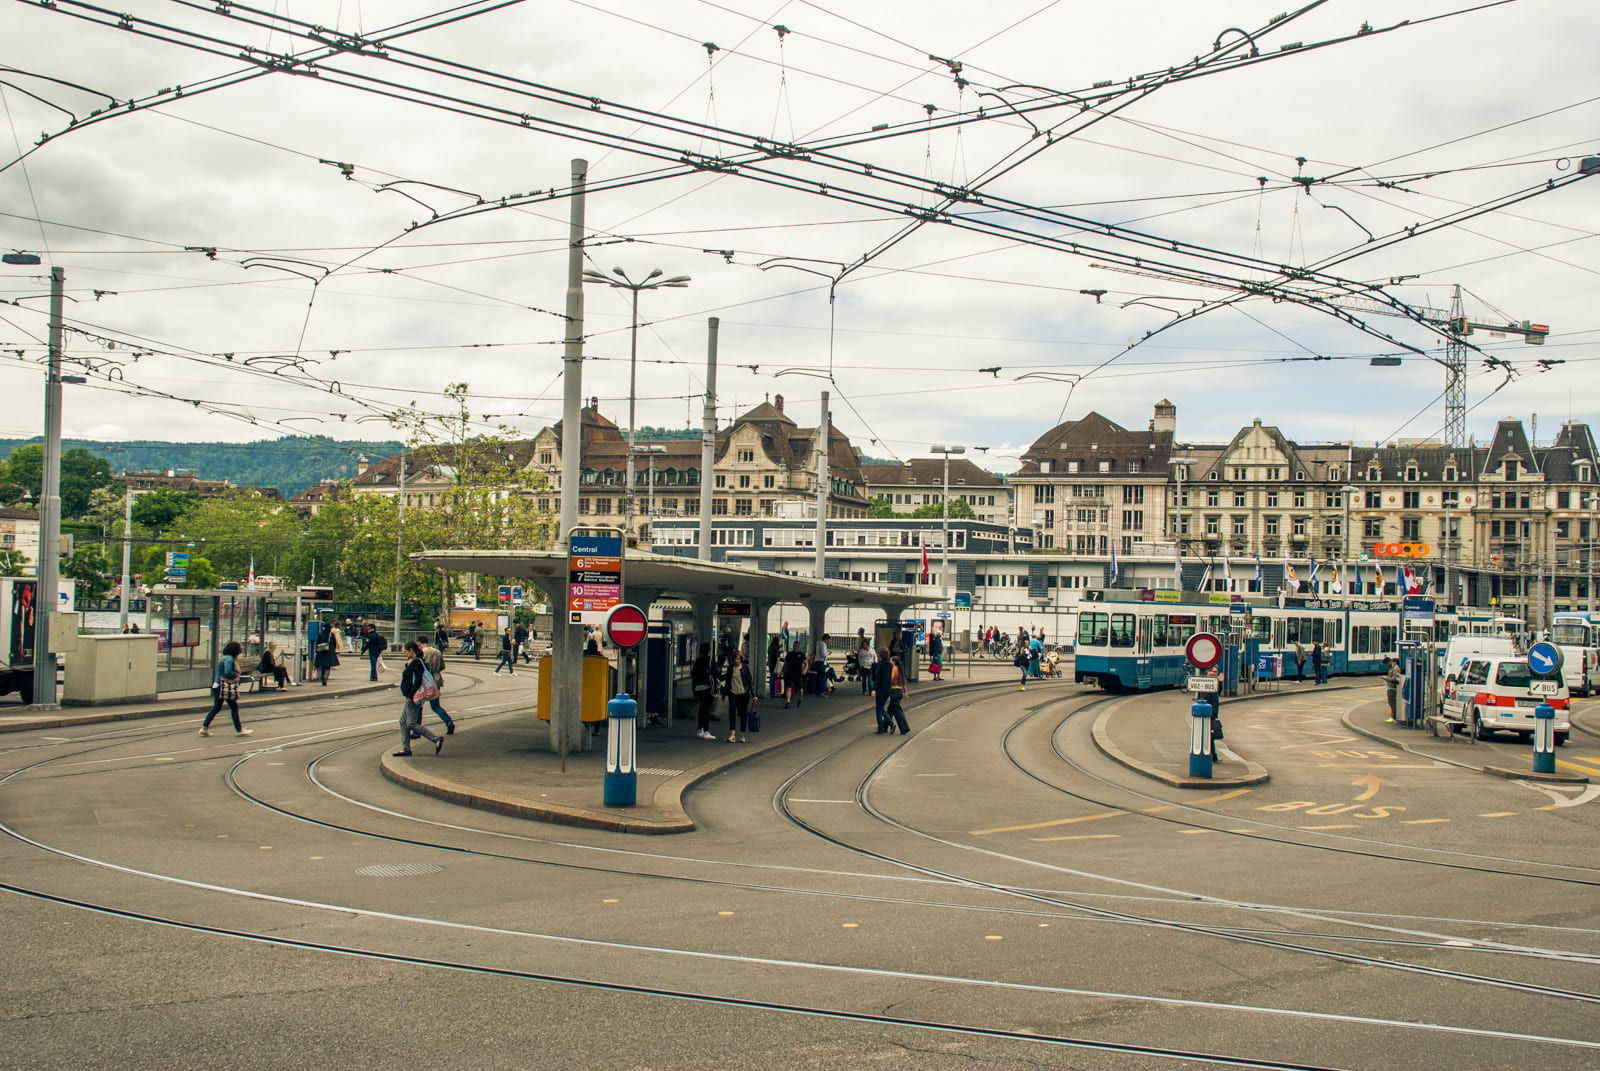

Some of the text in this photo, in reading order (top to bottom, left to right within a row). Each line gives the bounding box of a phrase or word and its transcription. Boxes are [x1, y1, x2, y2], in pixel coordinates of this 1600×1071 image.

[572, 545, 598, 553] Central
[1373, 542, 1431, 559] coop
[577, 559, 584, 568] 6
[577, 572, 584, 582] 7
[572, 586, 584, 596] 10
[1091, 591, 1099, 601] 7
[1541, 684, 1556, 692] BUS
[1253, 801, 1407, 818] BUS
